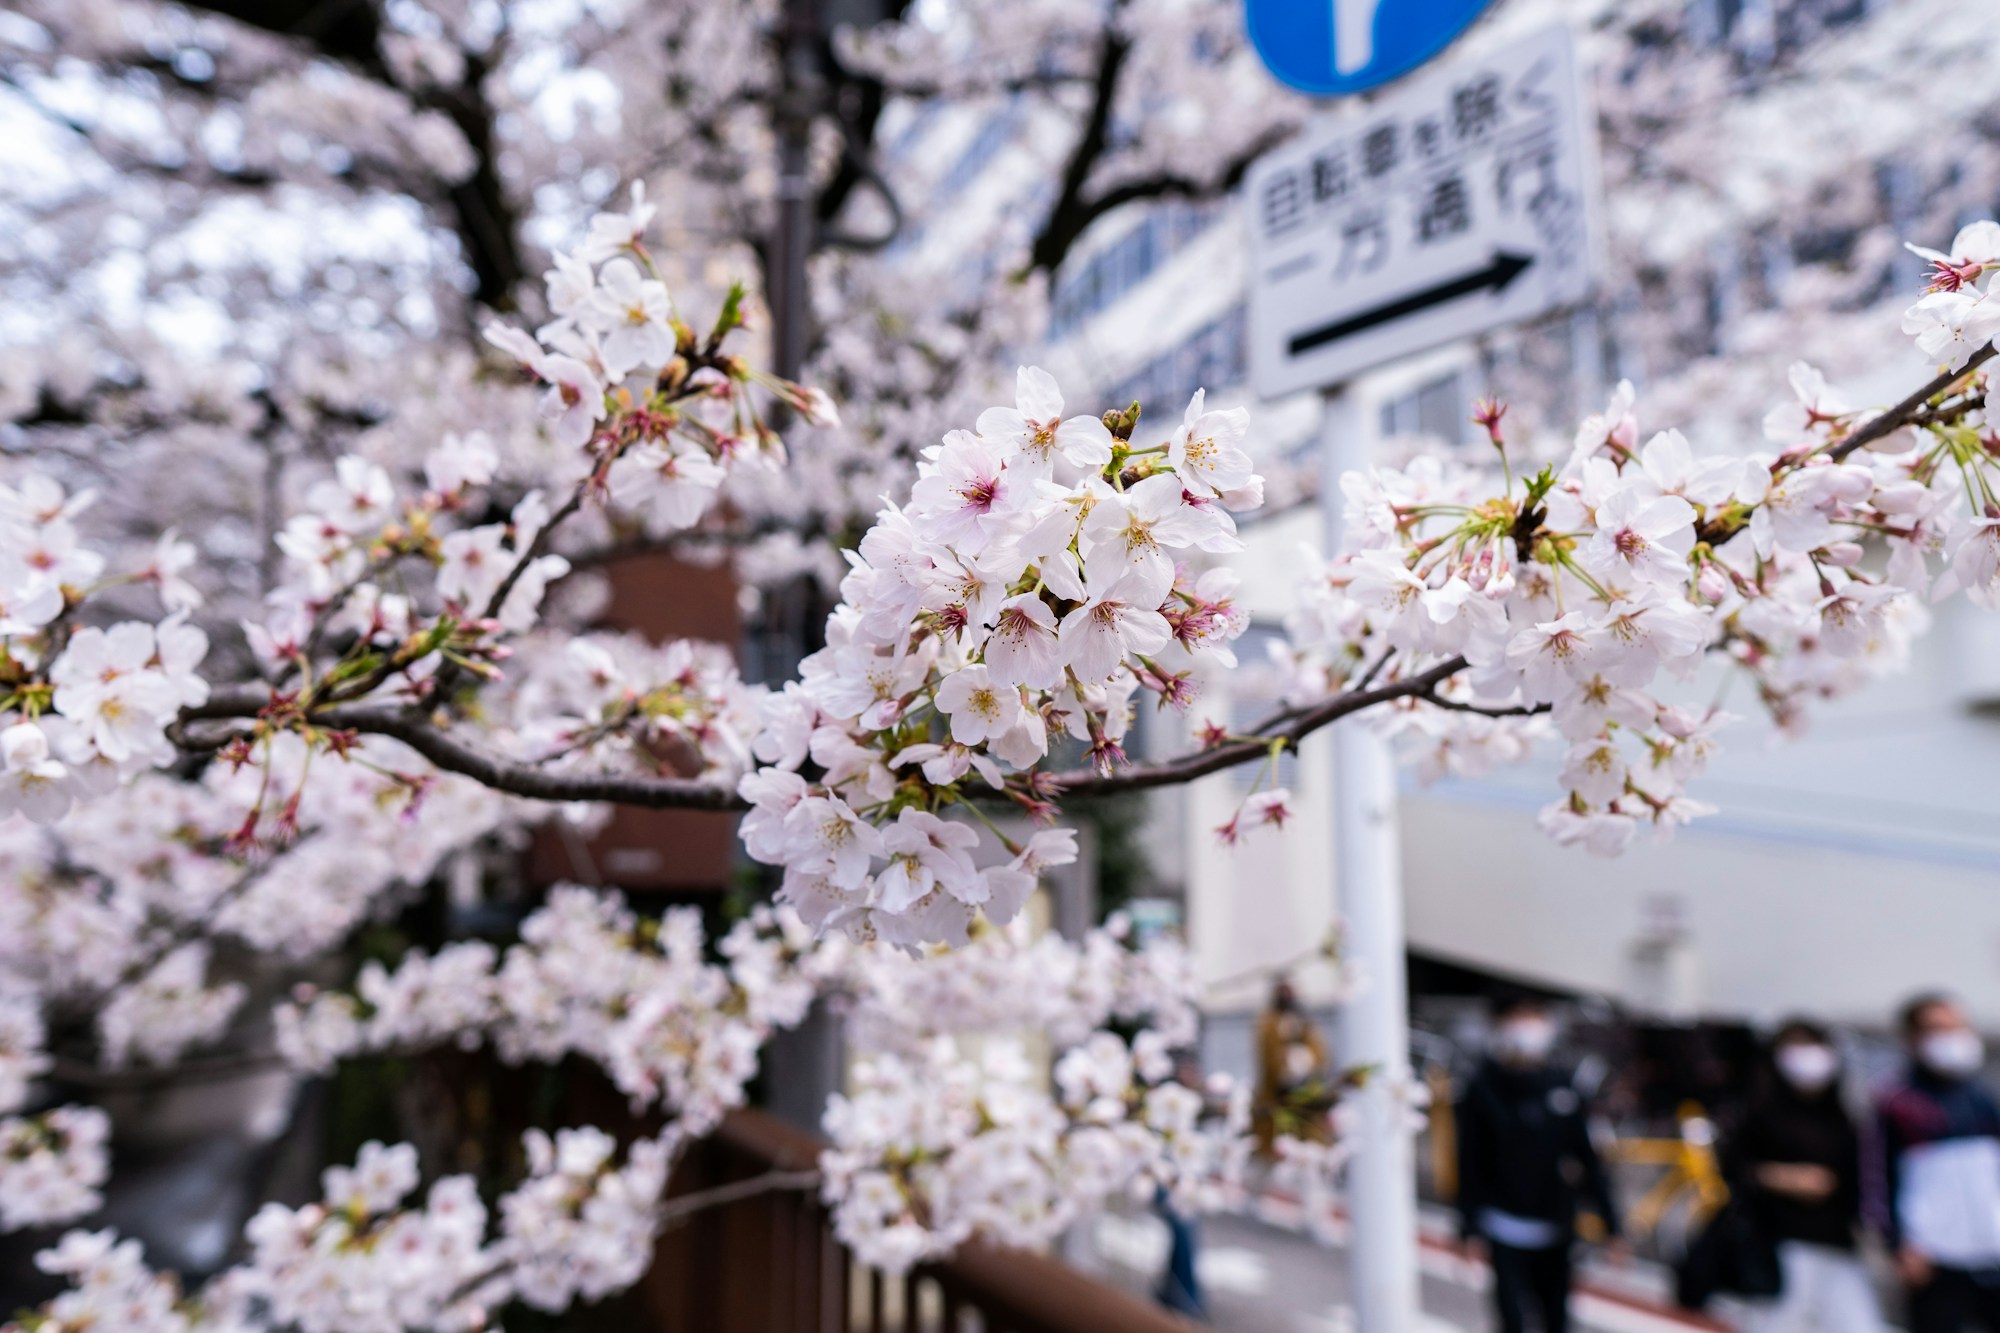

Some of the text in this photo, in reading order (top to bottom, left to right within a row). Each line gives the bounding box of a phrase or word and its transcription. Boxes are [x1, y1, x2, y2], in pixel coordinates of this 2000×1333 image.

[1264, 52, 1557, 238] 自転車を除く
[1266, 116, 1557, 282] 一方通行
